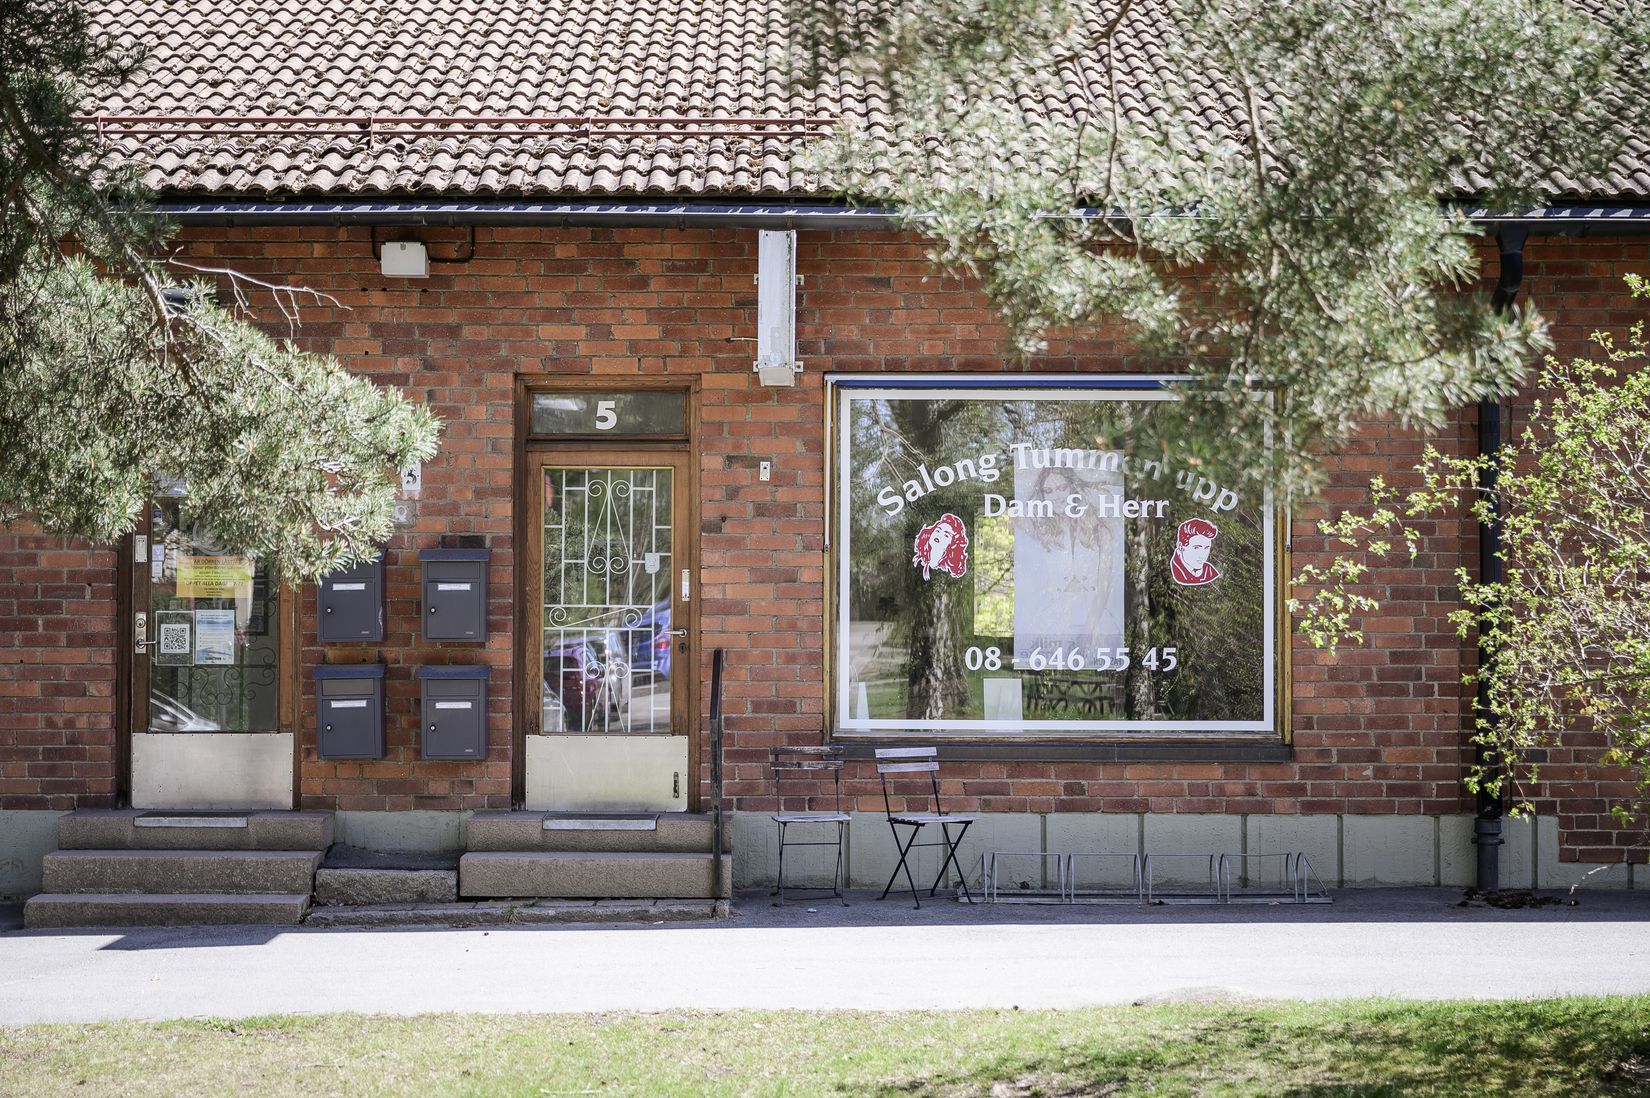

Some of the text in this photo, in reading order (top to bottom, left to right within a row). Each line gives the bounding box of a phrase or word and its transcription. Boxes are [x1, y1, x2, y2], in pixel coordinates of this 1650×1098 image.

[595, 400, 618, 430] 5
[876, 450, 1001, 518] Salong
[1175, 469, 1239, 514] upp
[984, 494, 1170, 518] Dam & Herr
[964, 646, 1178, 672] 08 - 646 55 45
